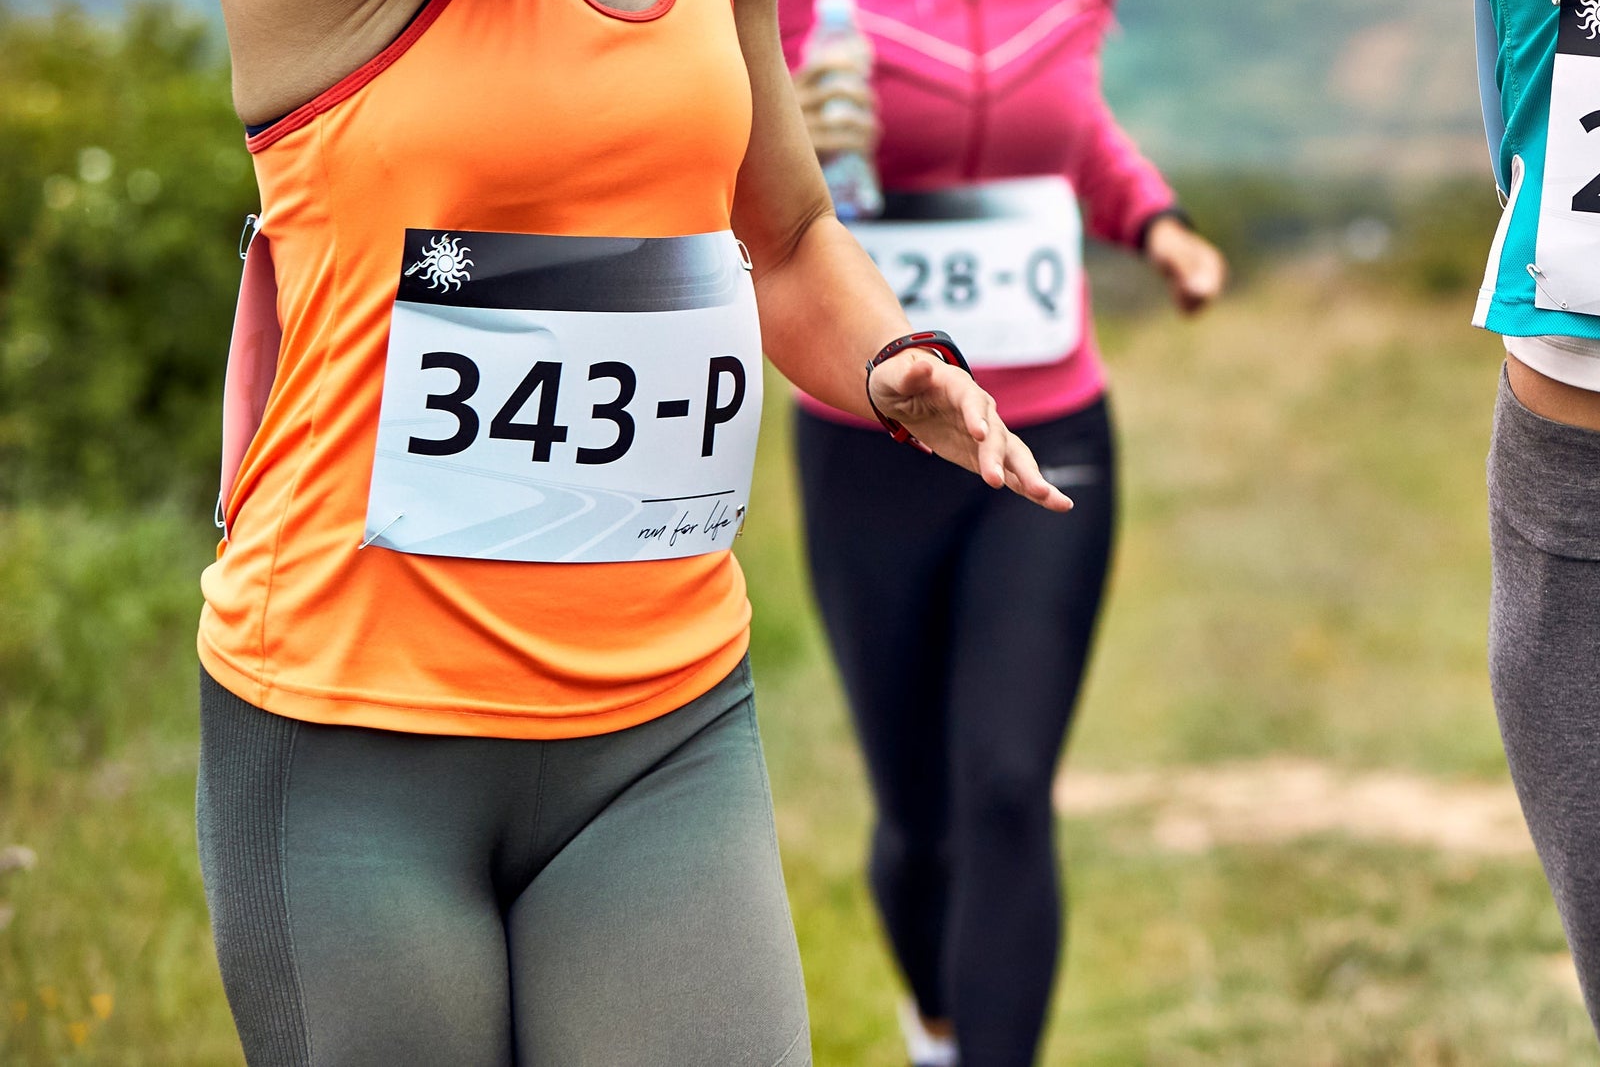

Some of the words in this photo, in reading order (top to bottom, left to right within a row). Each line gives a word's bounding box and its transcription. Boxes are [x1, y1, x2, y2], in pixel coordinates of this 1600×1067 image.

[868, 247, 1066, 319] 28-Q
[407, 351, 747, 465] 343-P
[637, 524, 667, 540] run
[669, 510, 699, 547] for
[703, 499, 732, 541] life
